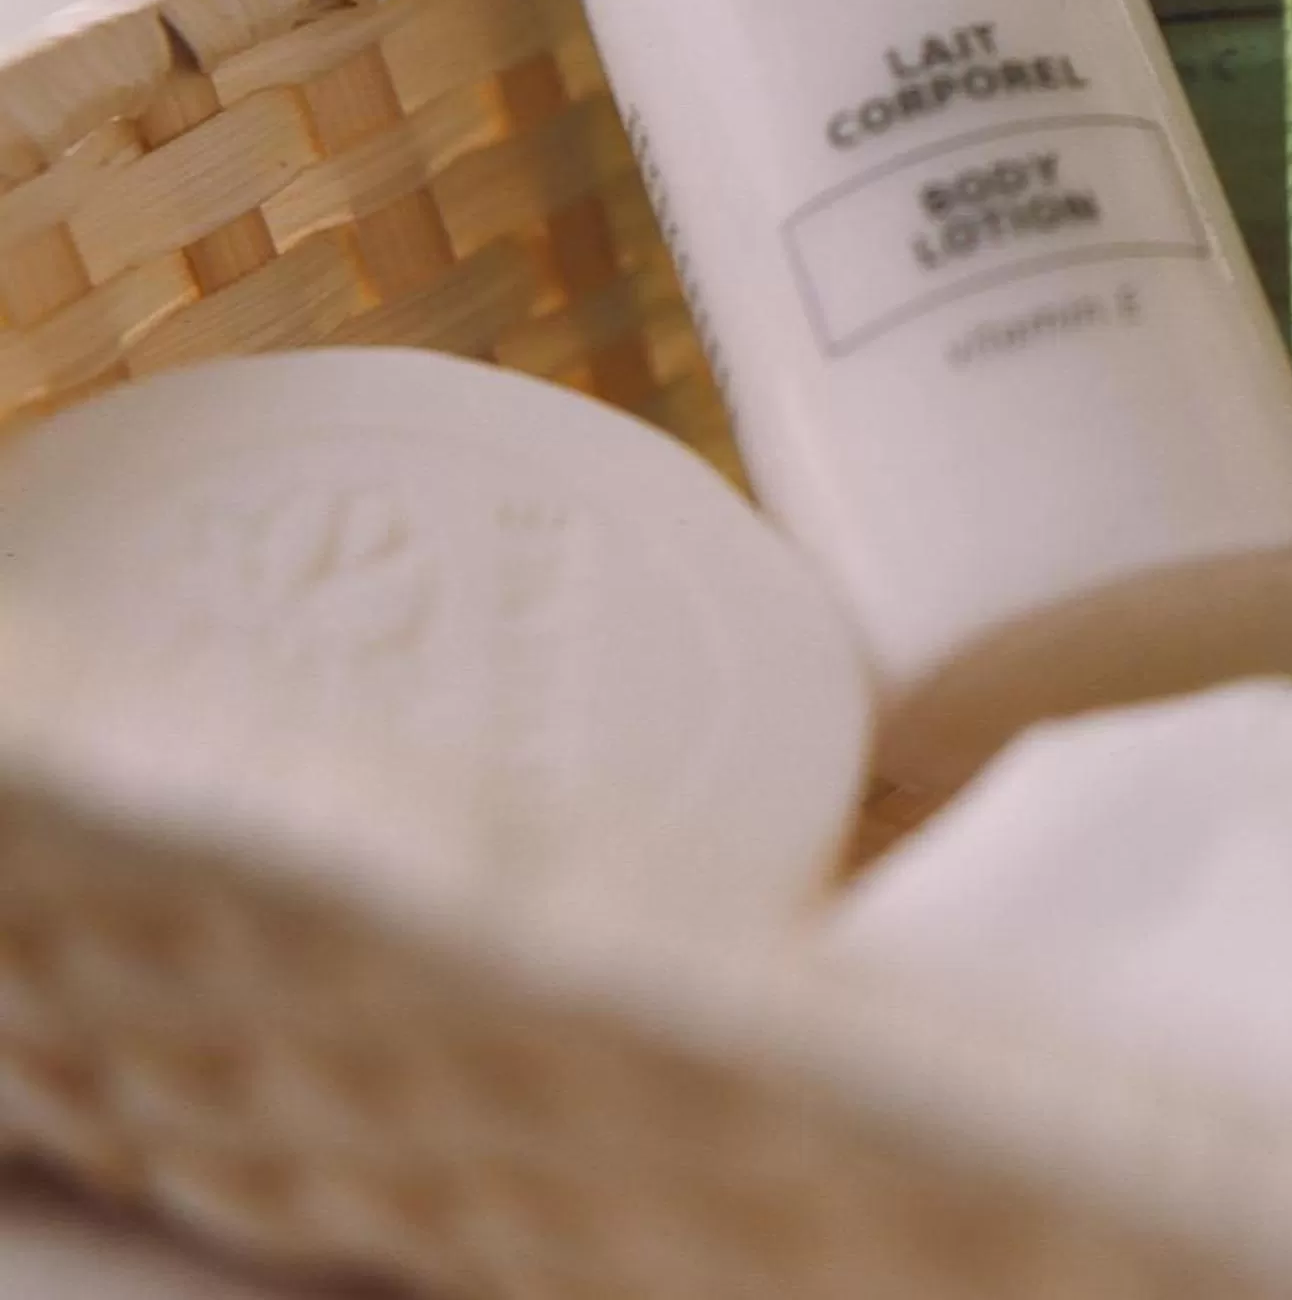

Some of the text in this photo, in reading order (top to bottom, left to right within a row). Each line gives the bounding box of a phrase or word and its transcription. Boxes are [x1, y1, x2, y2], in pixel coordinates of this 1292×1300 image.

[884, 22, 998, 80] LAIT
[826, 55, 1091, 152] CORPOREL
[917, 150, 1060, 224] BODY
[909, 187, 1104, 270] LOTION
